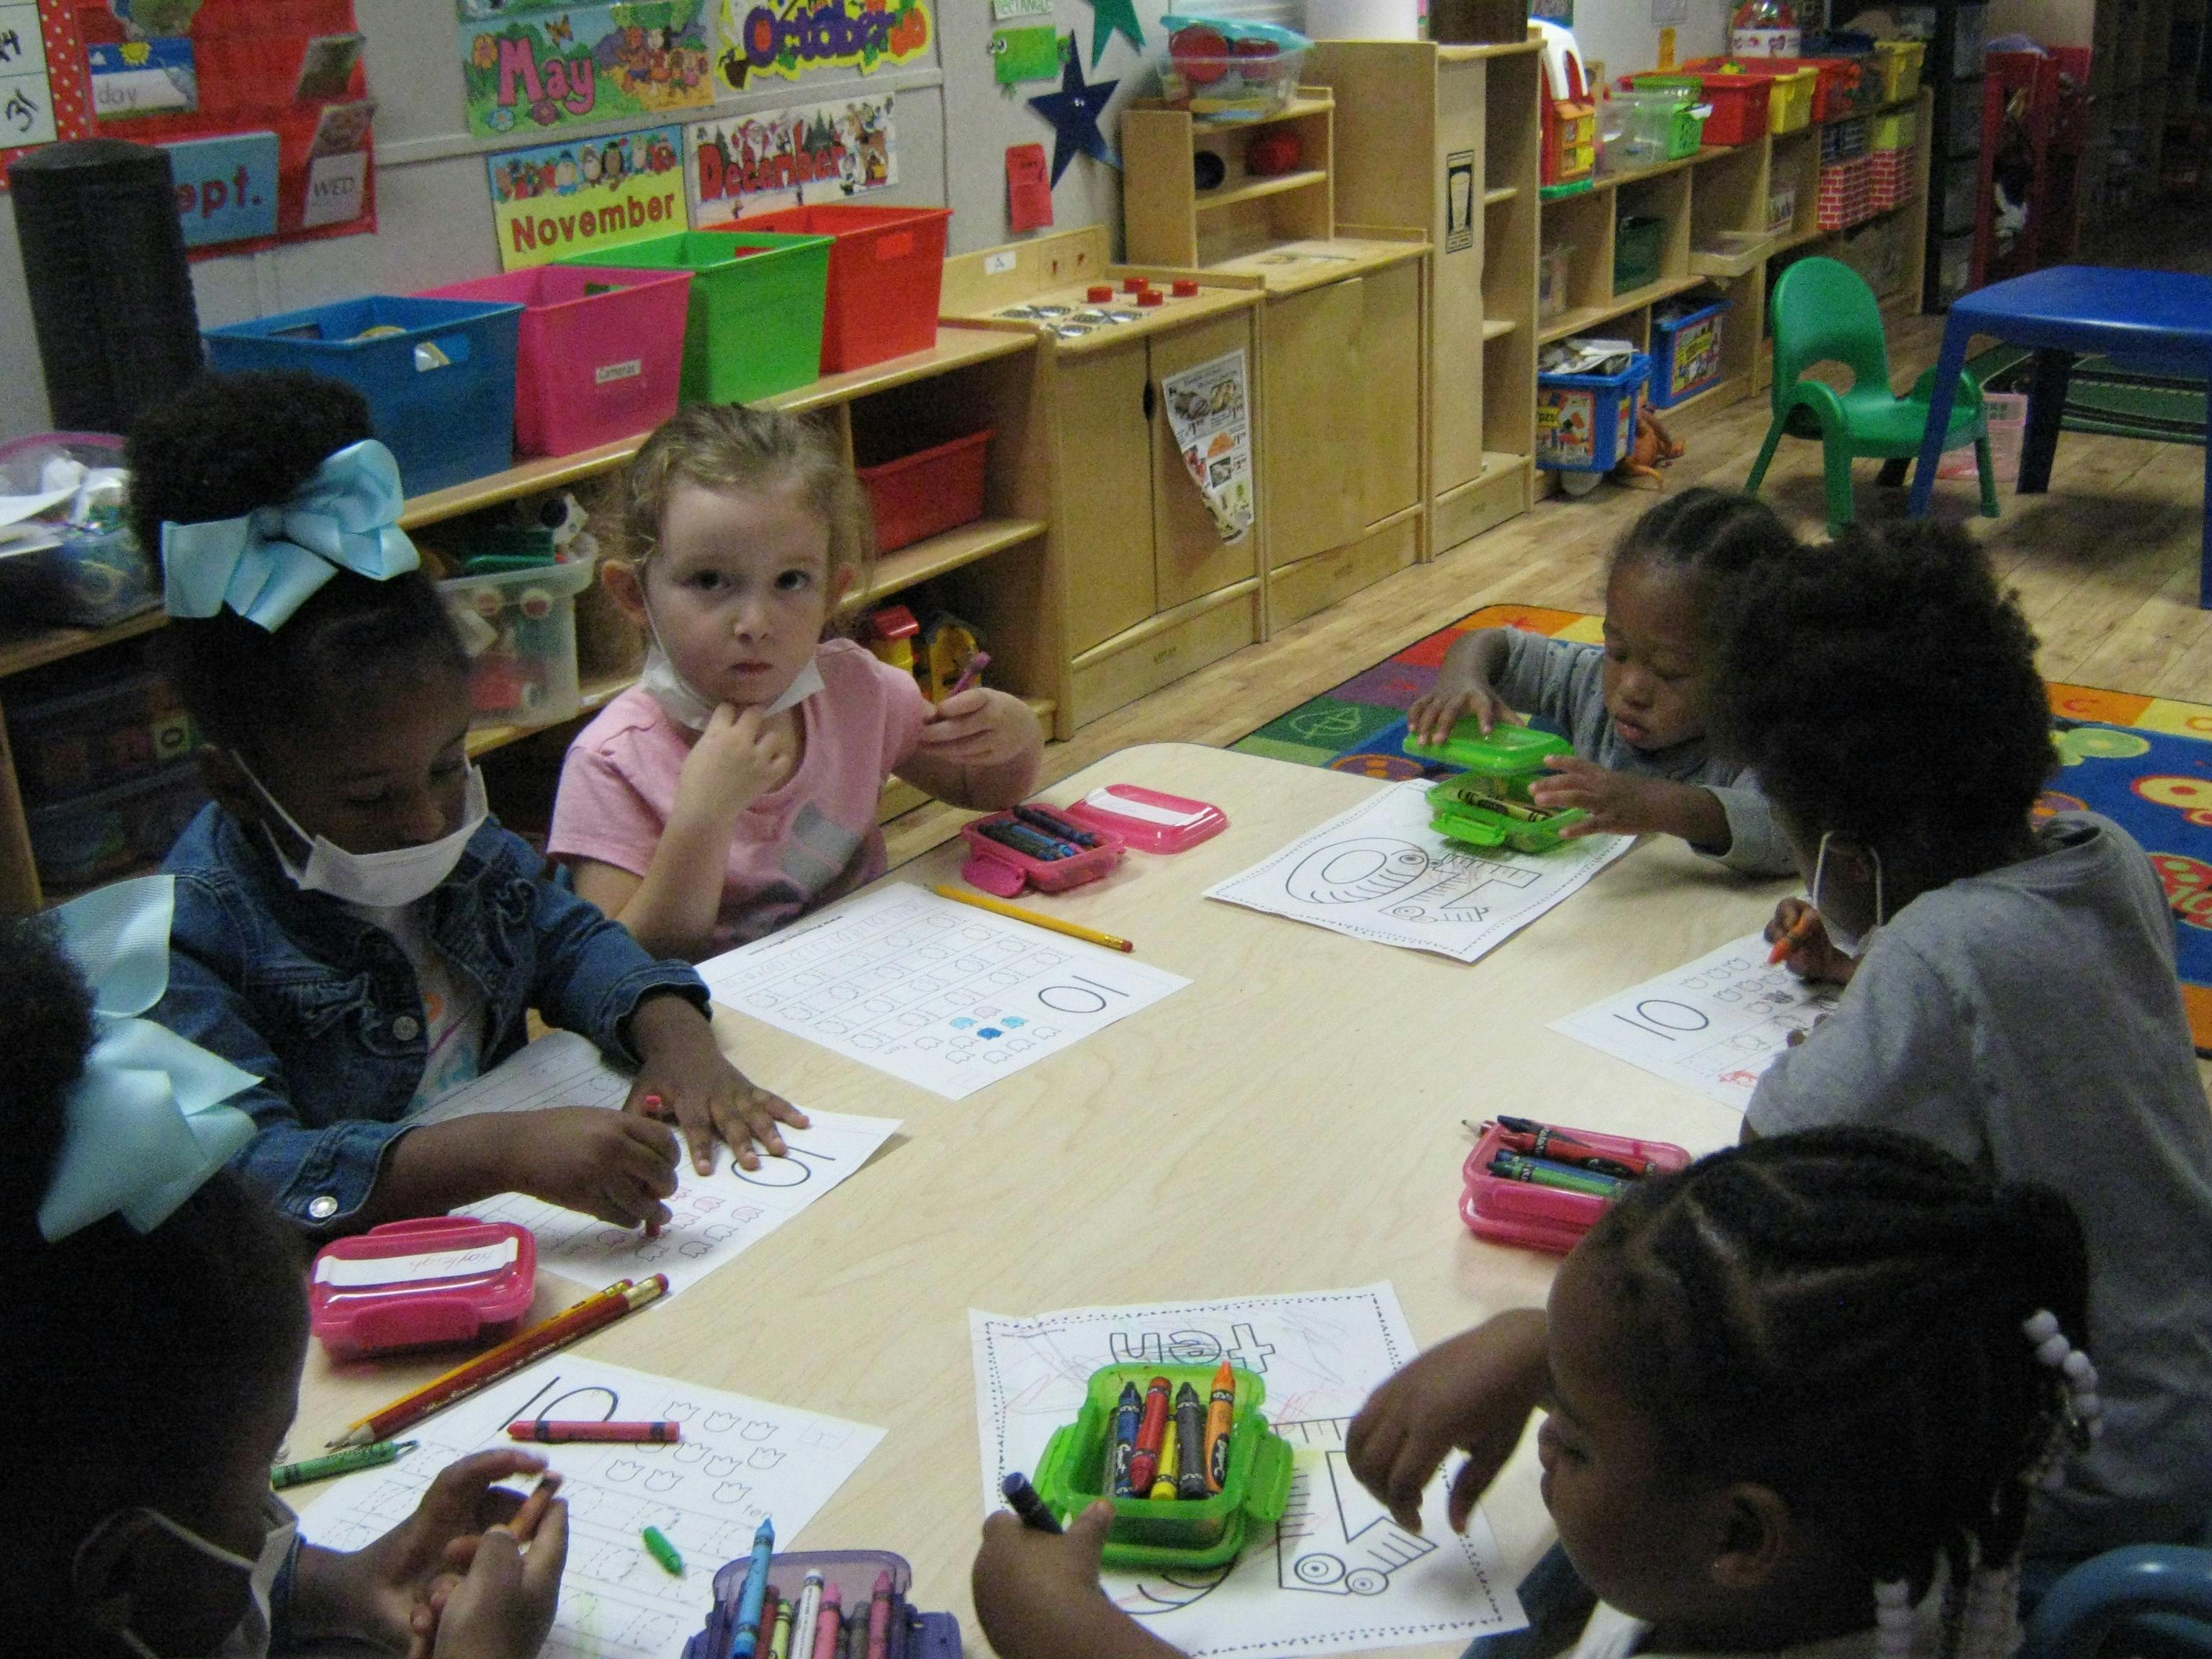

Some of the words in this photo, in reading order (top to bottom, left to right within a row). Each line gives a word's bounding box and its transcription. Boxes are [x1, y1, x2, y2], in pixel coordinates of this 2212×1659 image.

[744, 0, 896, 68] October
[498, 37, 595, 115] May
[6, 87, 38, 132] 31
[698, 119, 847, 202] December
[176, 166, 262, 219] ept.
[511, 193, 674, 253] November
[1037, 975, 1130, 1014] 10
[1612, 999, 1710, 1041] 10
[1109, 1323, 1276, 1374] ten
